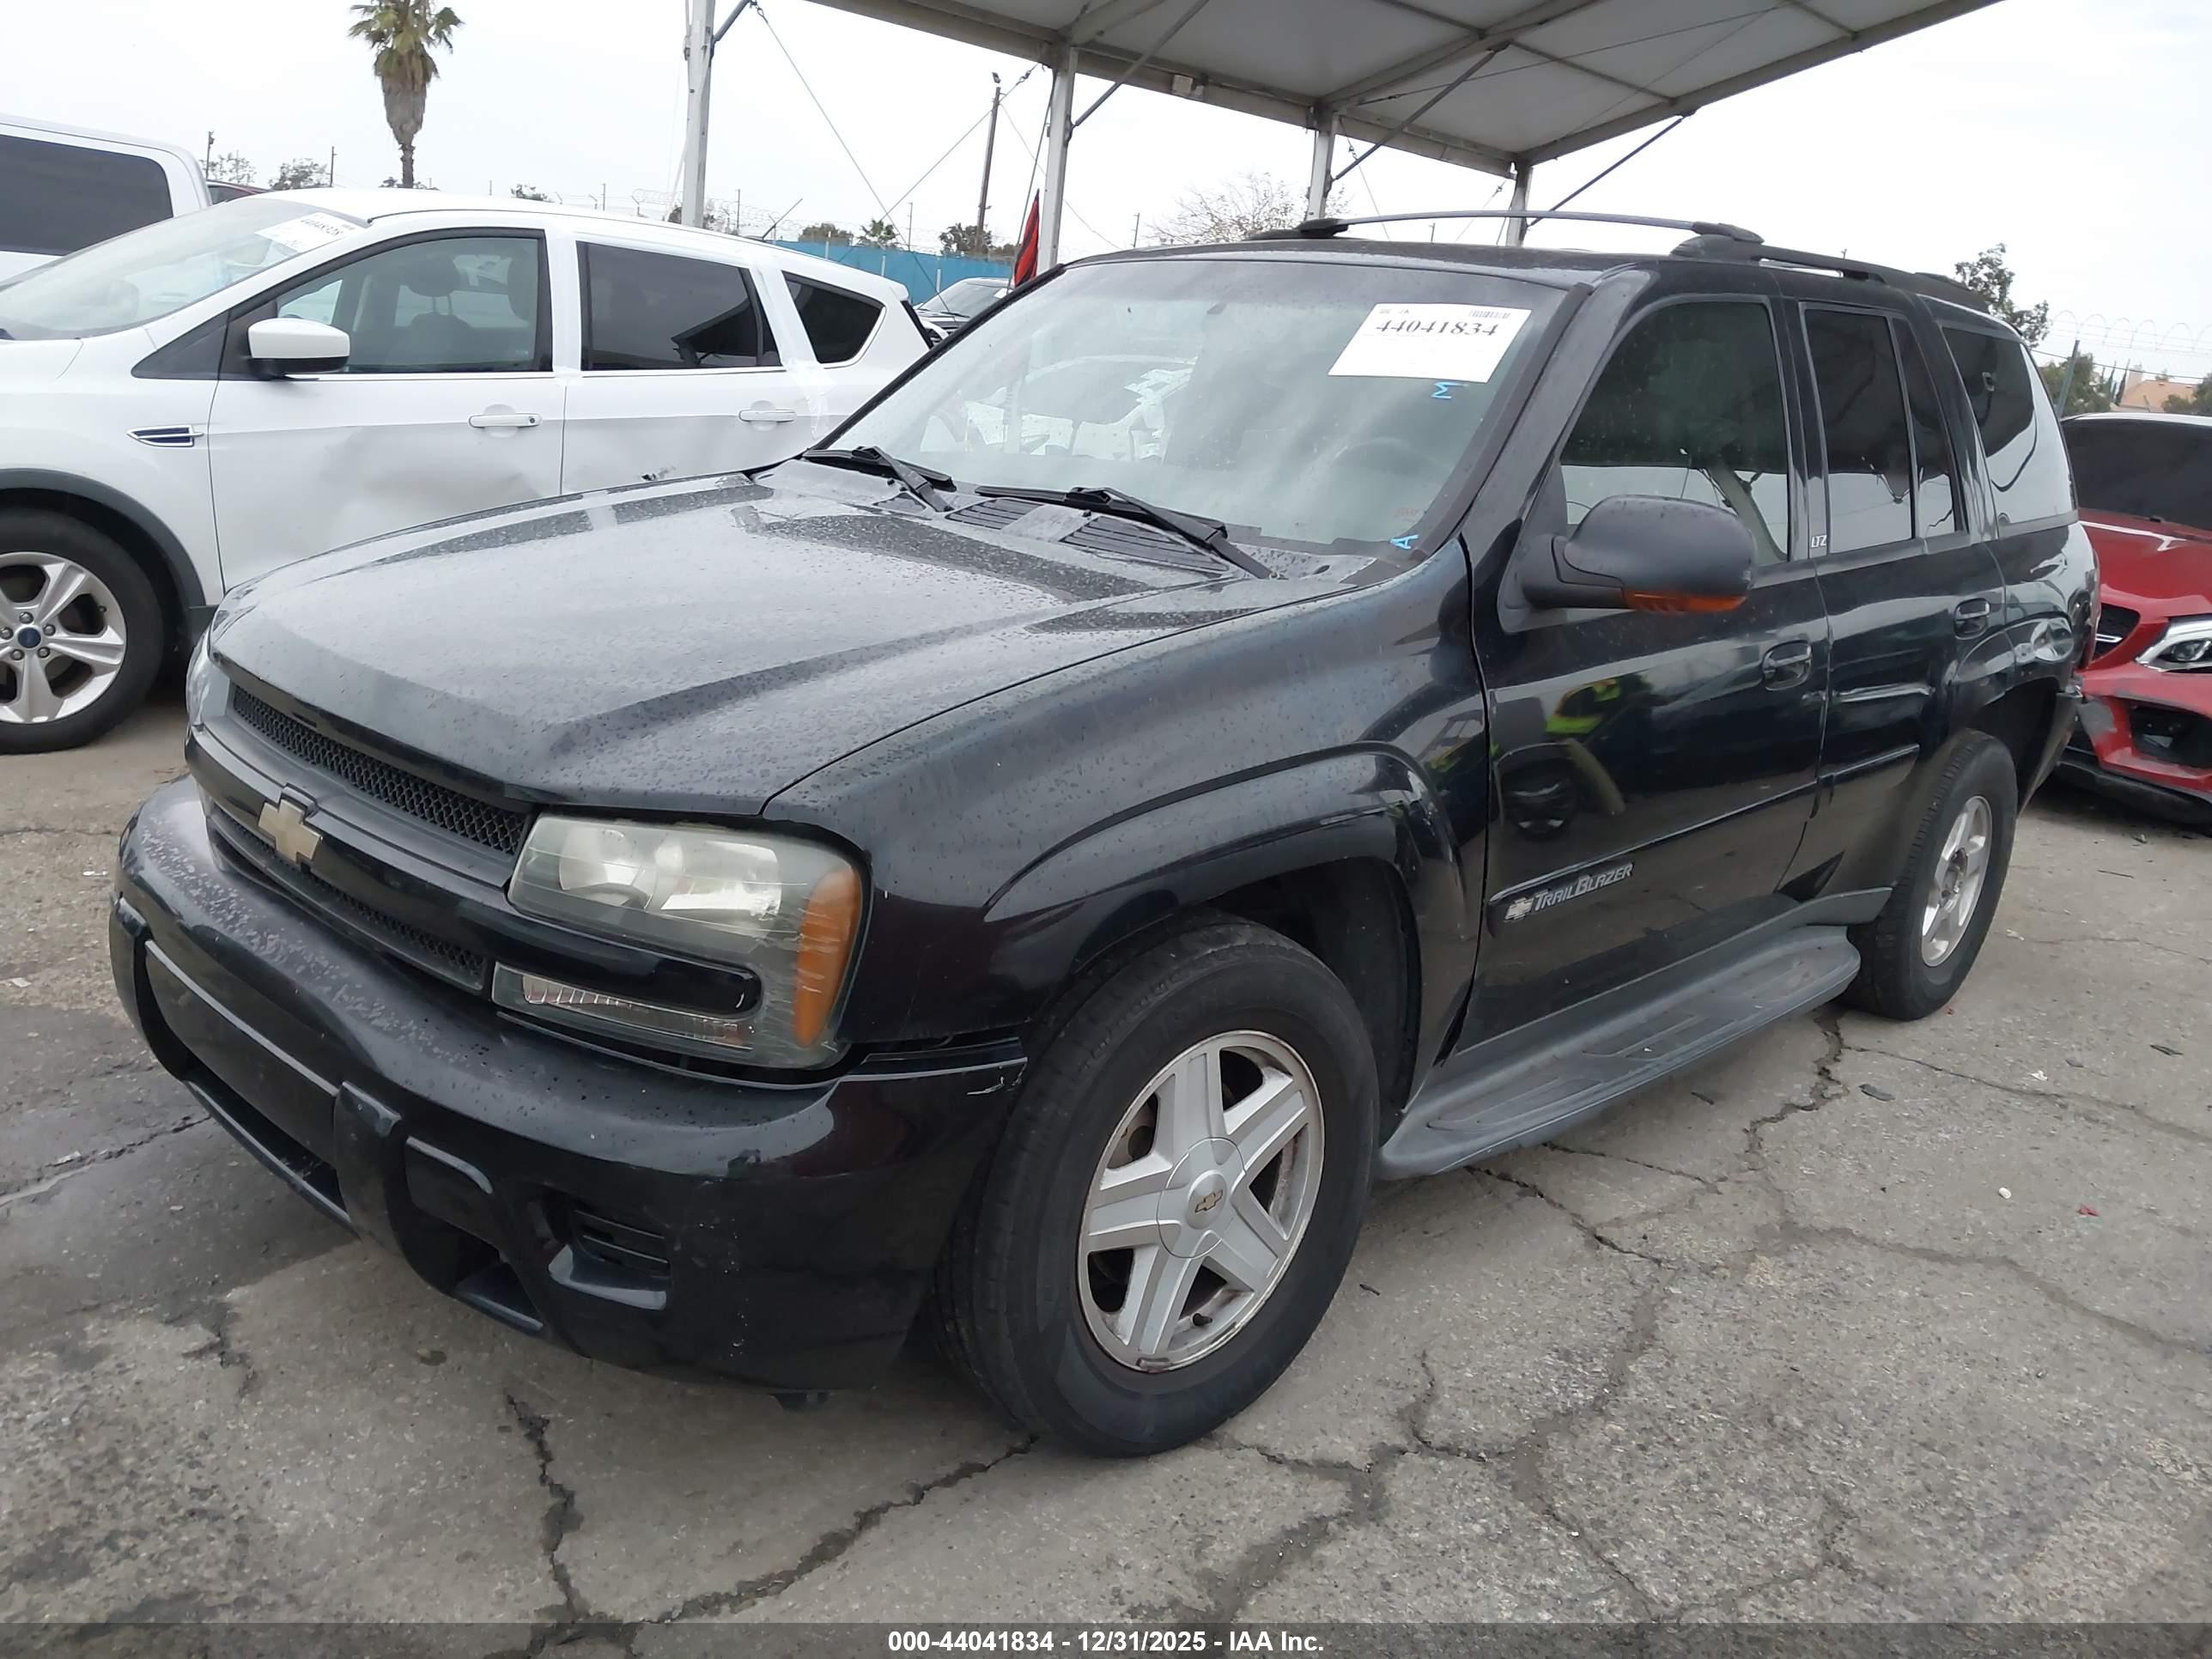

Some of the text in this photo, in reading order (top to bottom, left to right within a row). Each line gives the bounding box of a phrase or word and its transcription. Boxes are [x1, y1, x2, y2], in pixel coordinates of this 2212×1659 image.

[1376, 319, 1499, 336] 44041834
[1389, 534, 1419, 550] A
[1811, 534, 1827, 548] LTZ
